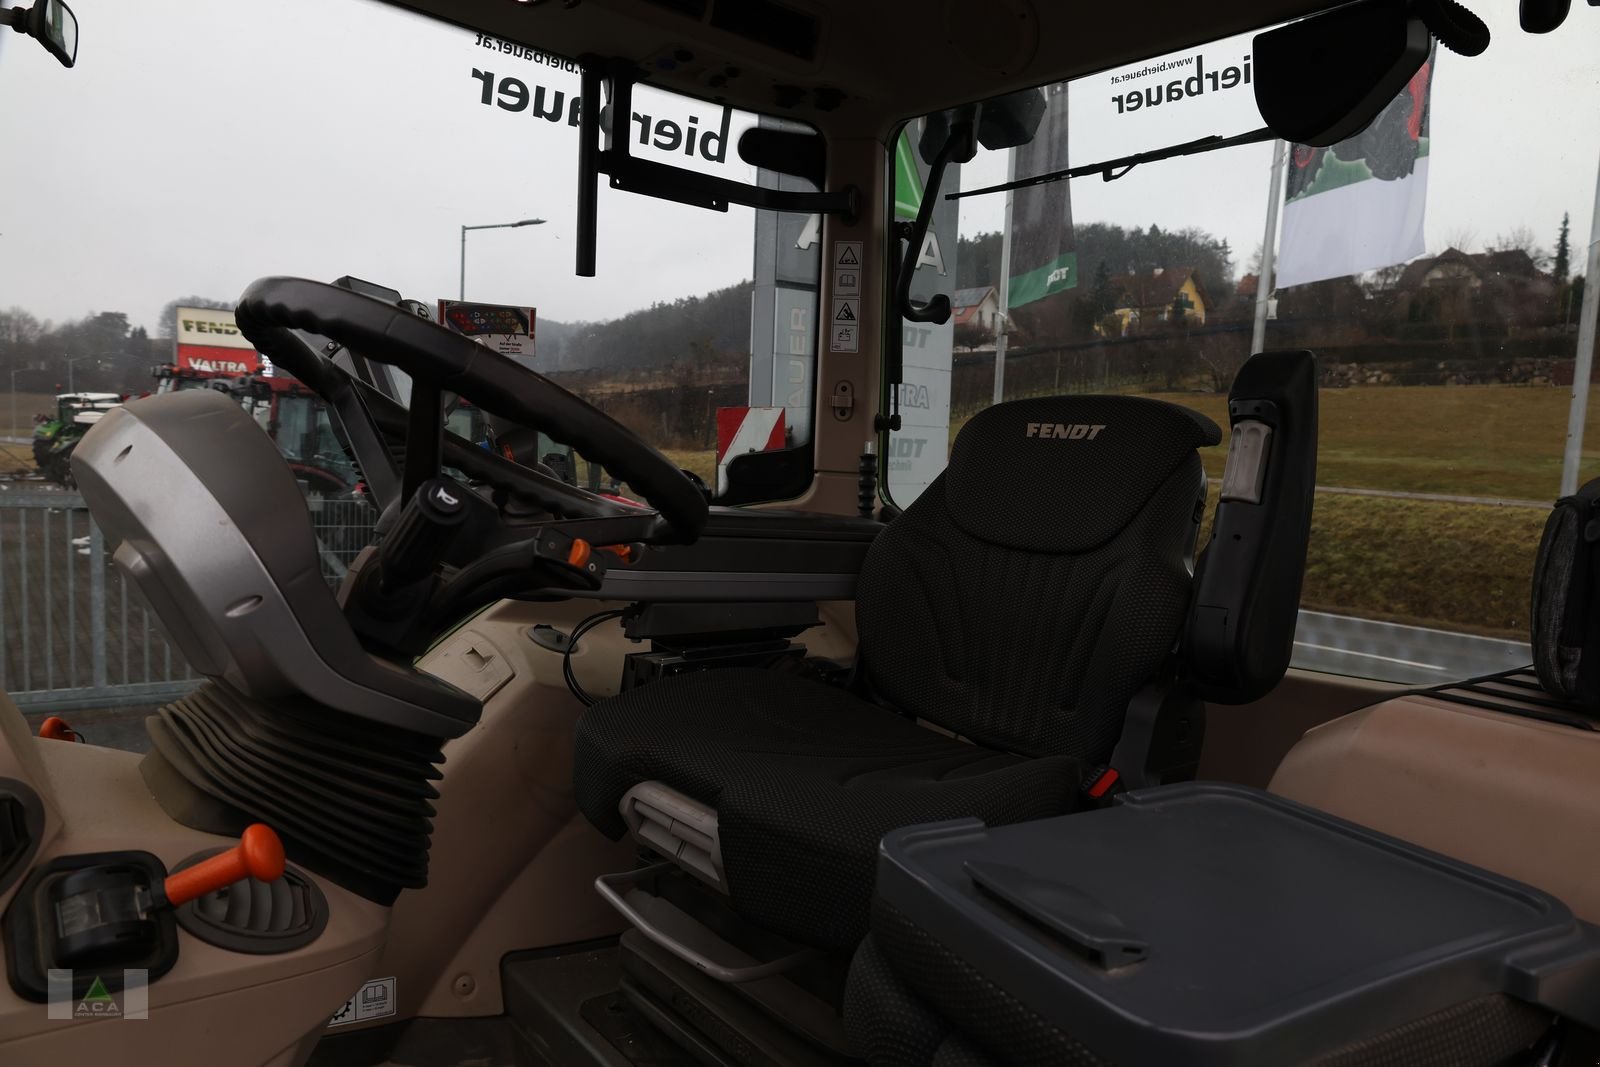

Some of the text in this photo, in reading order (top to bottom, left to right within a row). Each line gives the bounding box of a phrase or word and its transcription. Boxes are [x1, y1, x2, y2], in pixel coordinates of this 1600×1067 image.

[182, 319, 240, 336] FEND
[187, 357, 248, 373] VALTRA
[1026, 422, 1107, 441] FENDT
